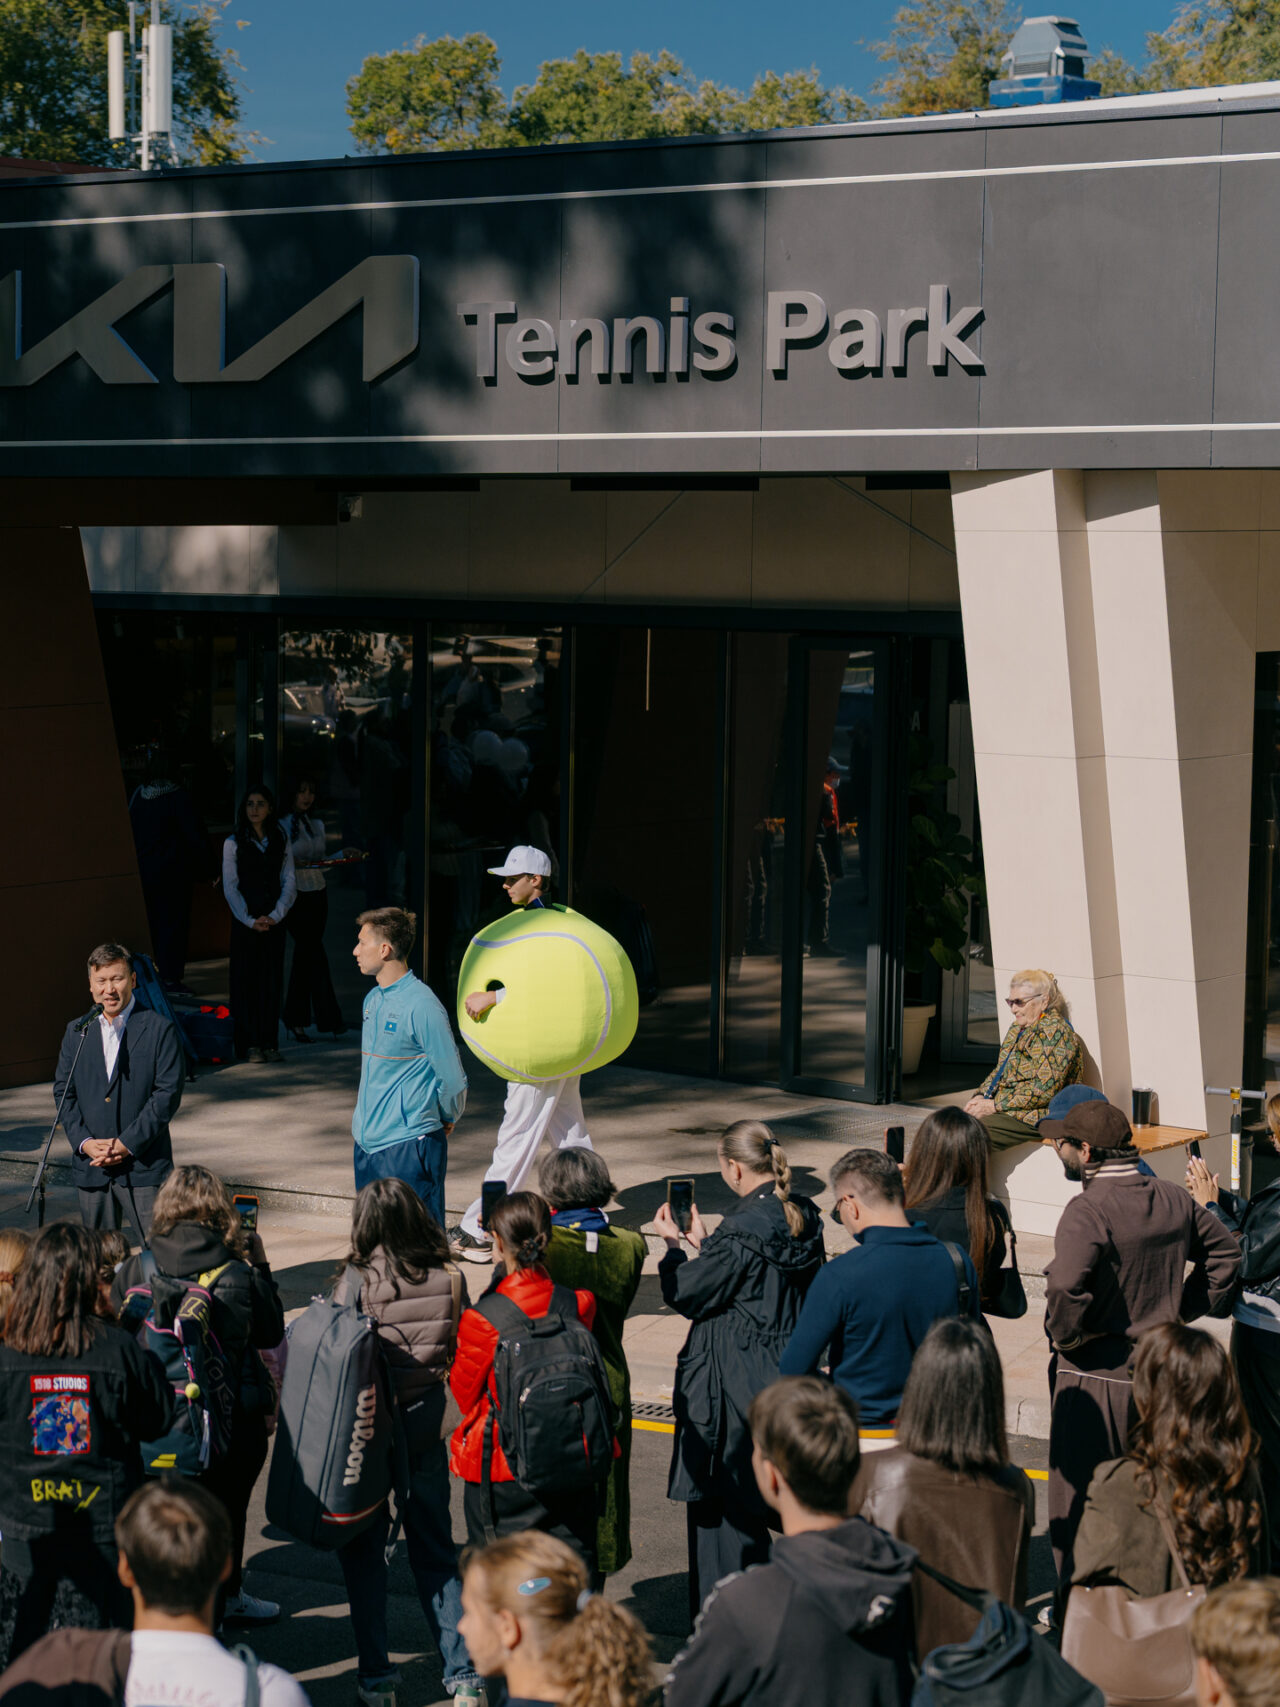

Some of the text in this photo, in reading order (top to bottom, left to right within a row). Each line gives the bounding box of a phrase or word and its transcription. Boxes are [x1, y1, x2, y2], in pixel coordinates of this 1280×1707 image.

[457, 283, 986, 387] Tennis Park
[53, 1376, 88, 1391] STUDIOS
